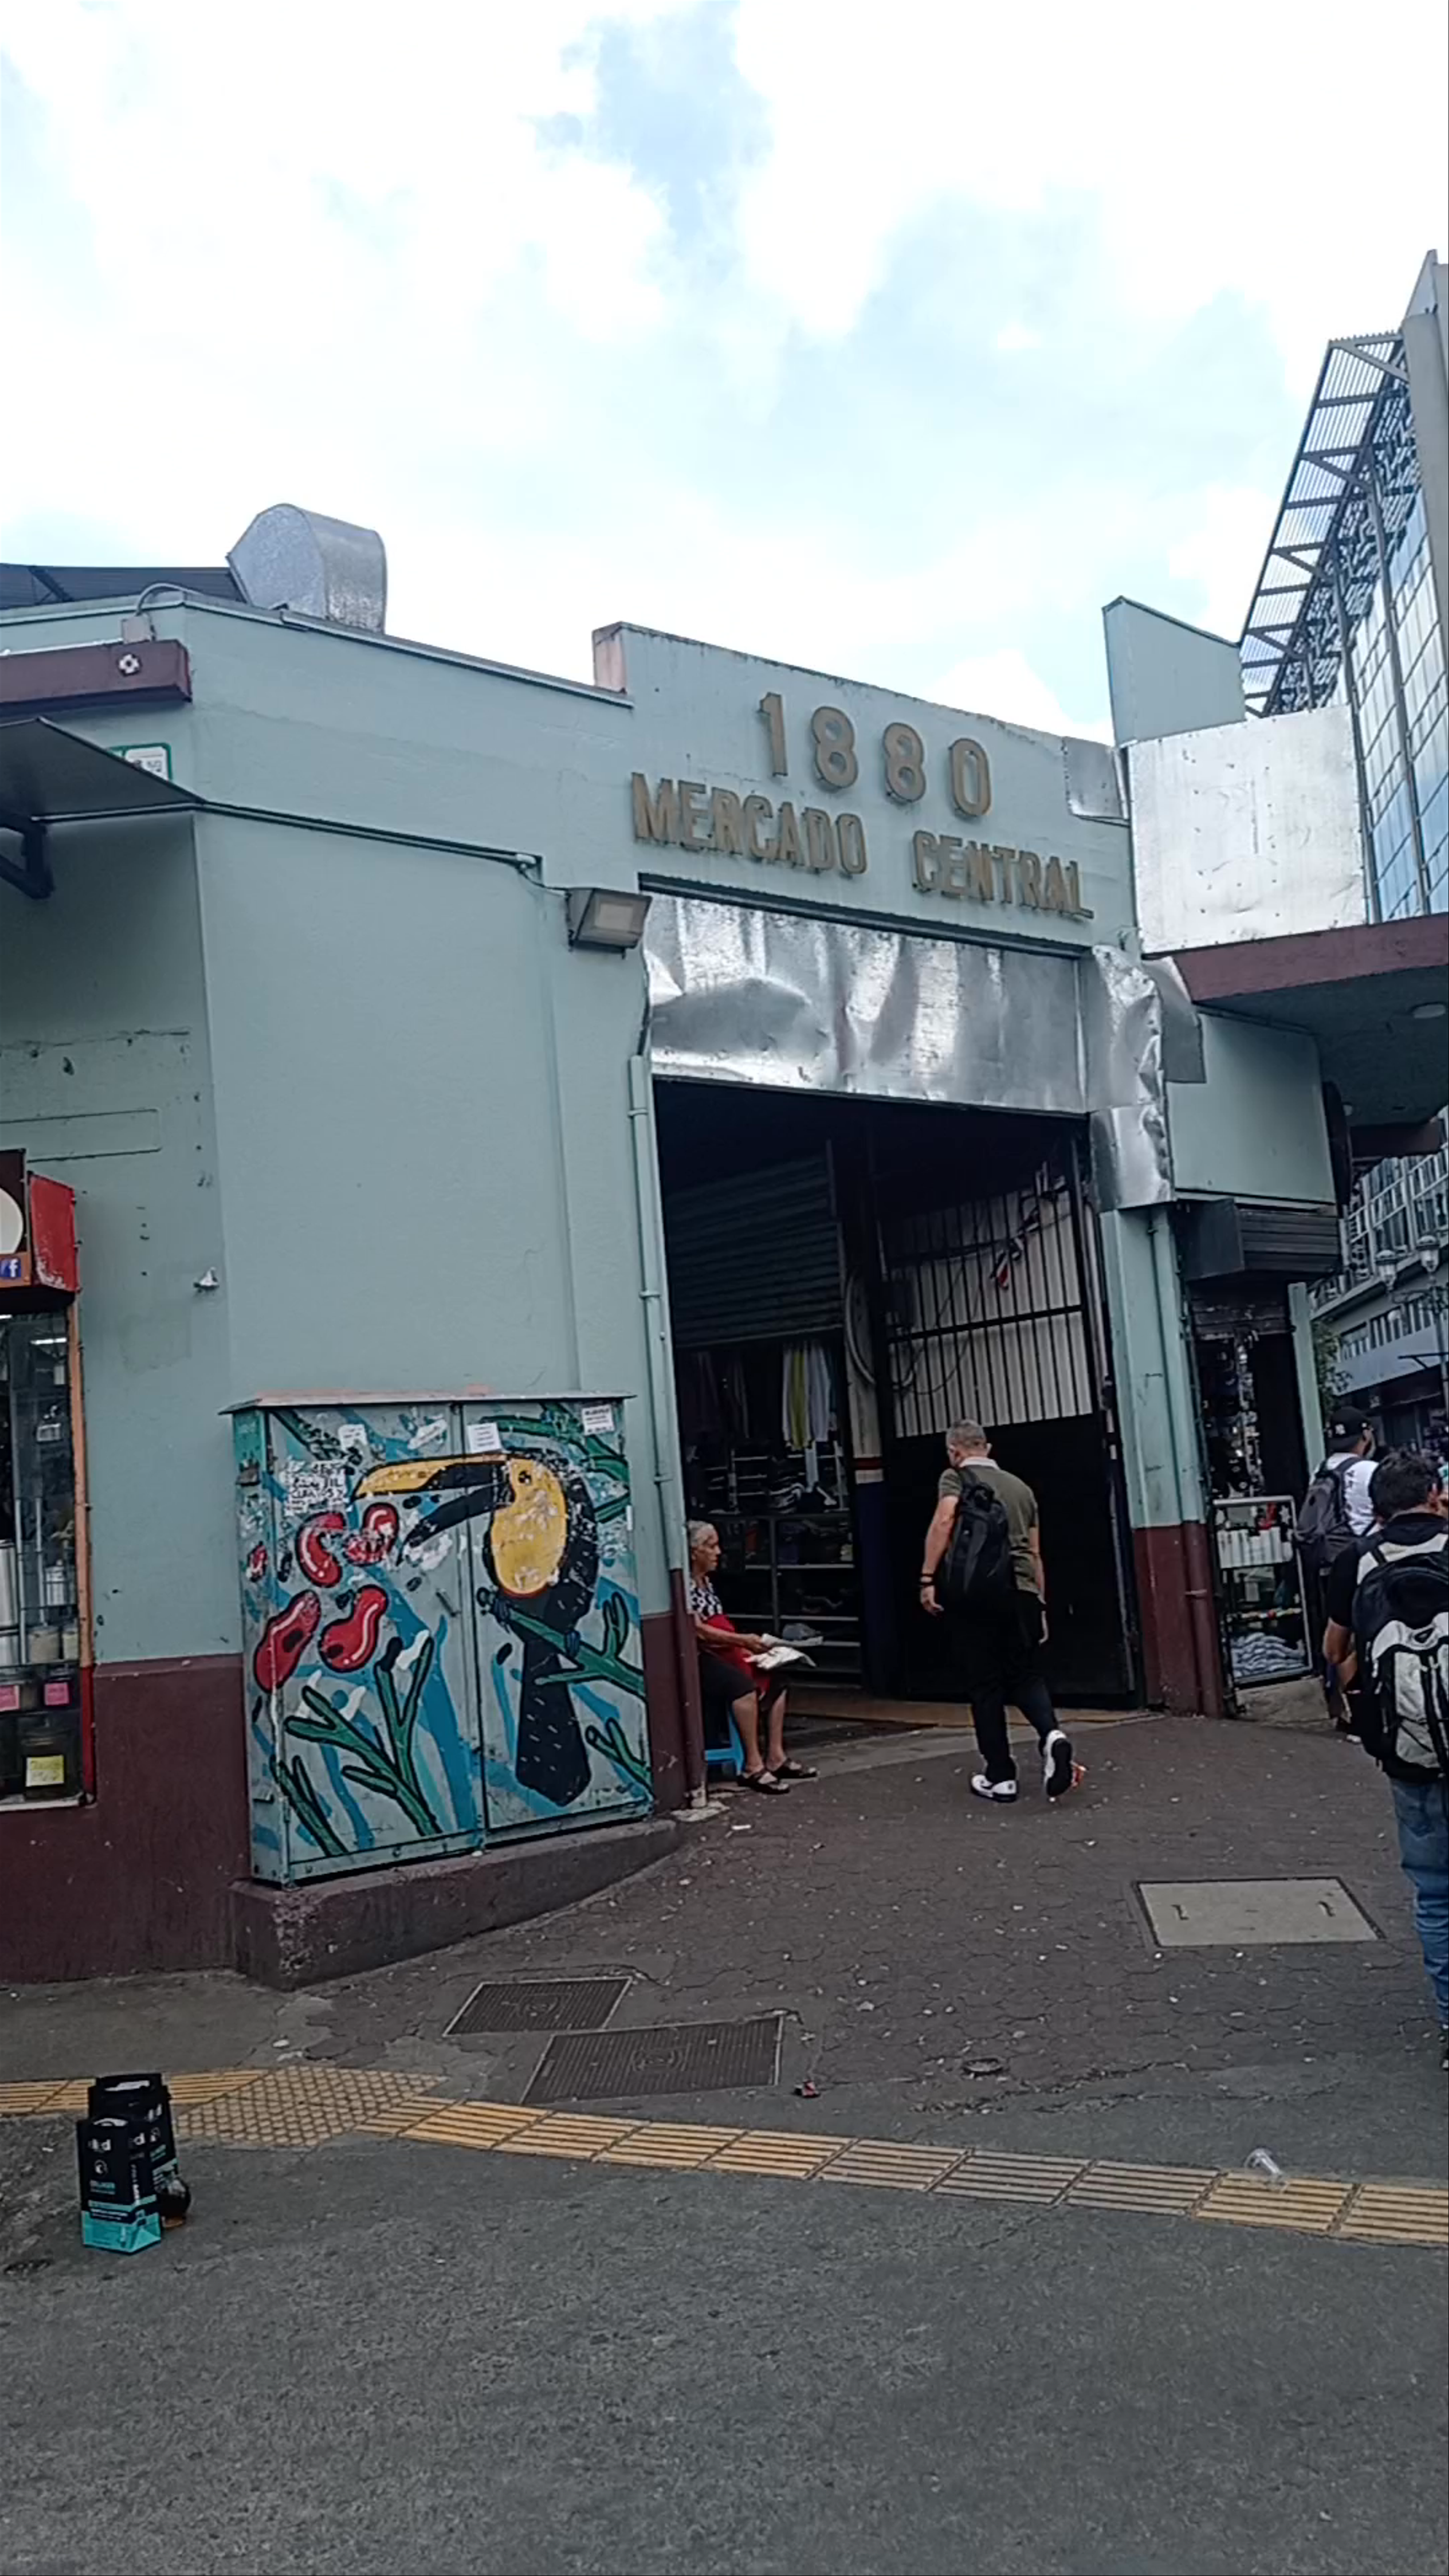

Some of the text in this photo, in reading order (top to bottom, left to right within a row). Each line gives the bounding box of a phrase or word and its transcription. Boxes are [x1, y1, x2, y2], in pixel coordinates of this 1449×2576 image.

[758, 692, 992, 817] 1880
[631, 772, 1094, 918] MERCADO CENTRAL
